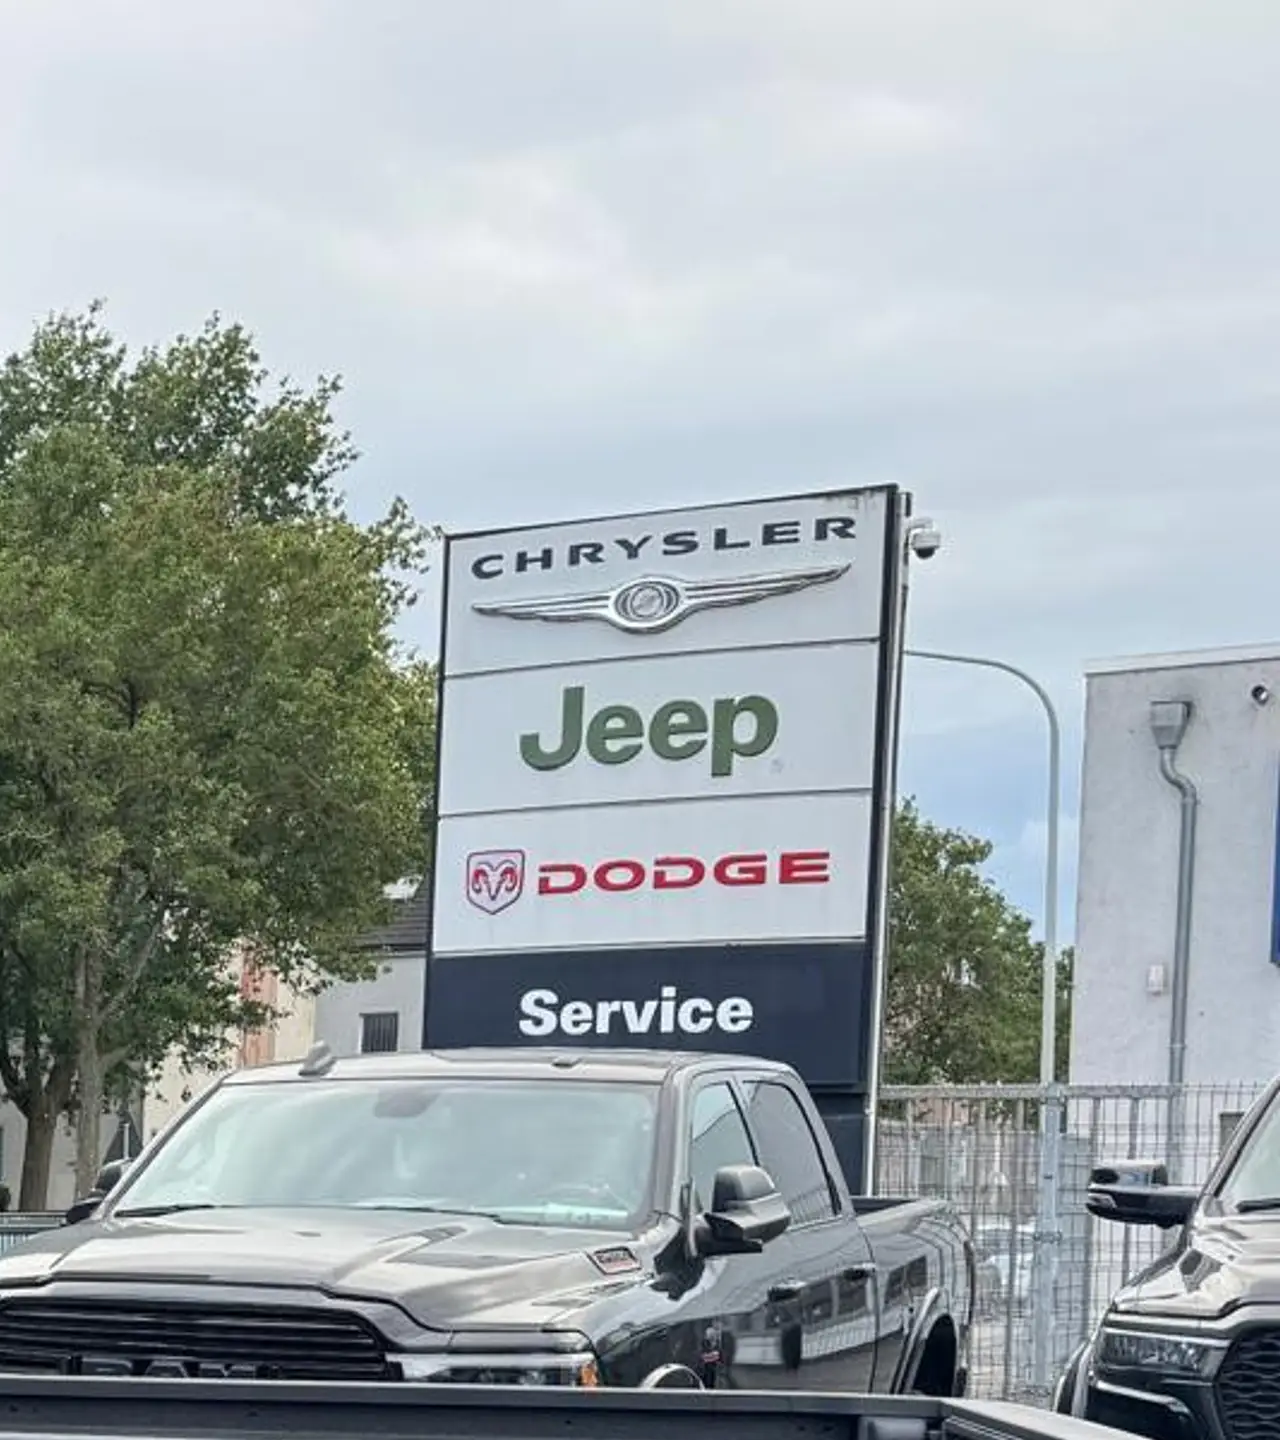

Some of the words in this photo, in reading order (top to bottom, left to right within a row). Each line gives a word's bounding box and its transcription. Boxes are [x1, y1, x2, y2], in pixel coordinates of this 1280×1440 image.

[471, 516, 856, 580] CHRYSLER
[519, 686, 779, 777] Jeep
[538, 851, 829, 896] DODGE
[519, 986, 754, 1036] Service
